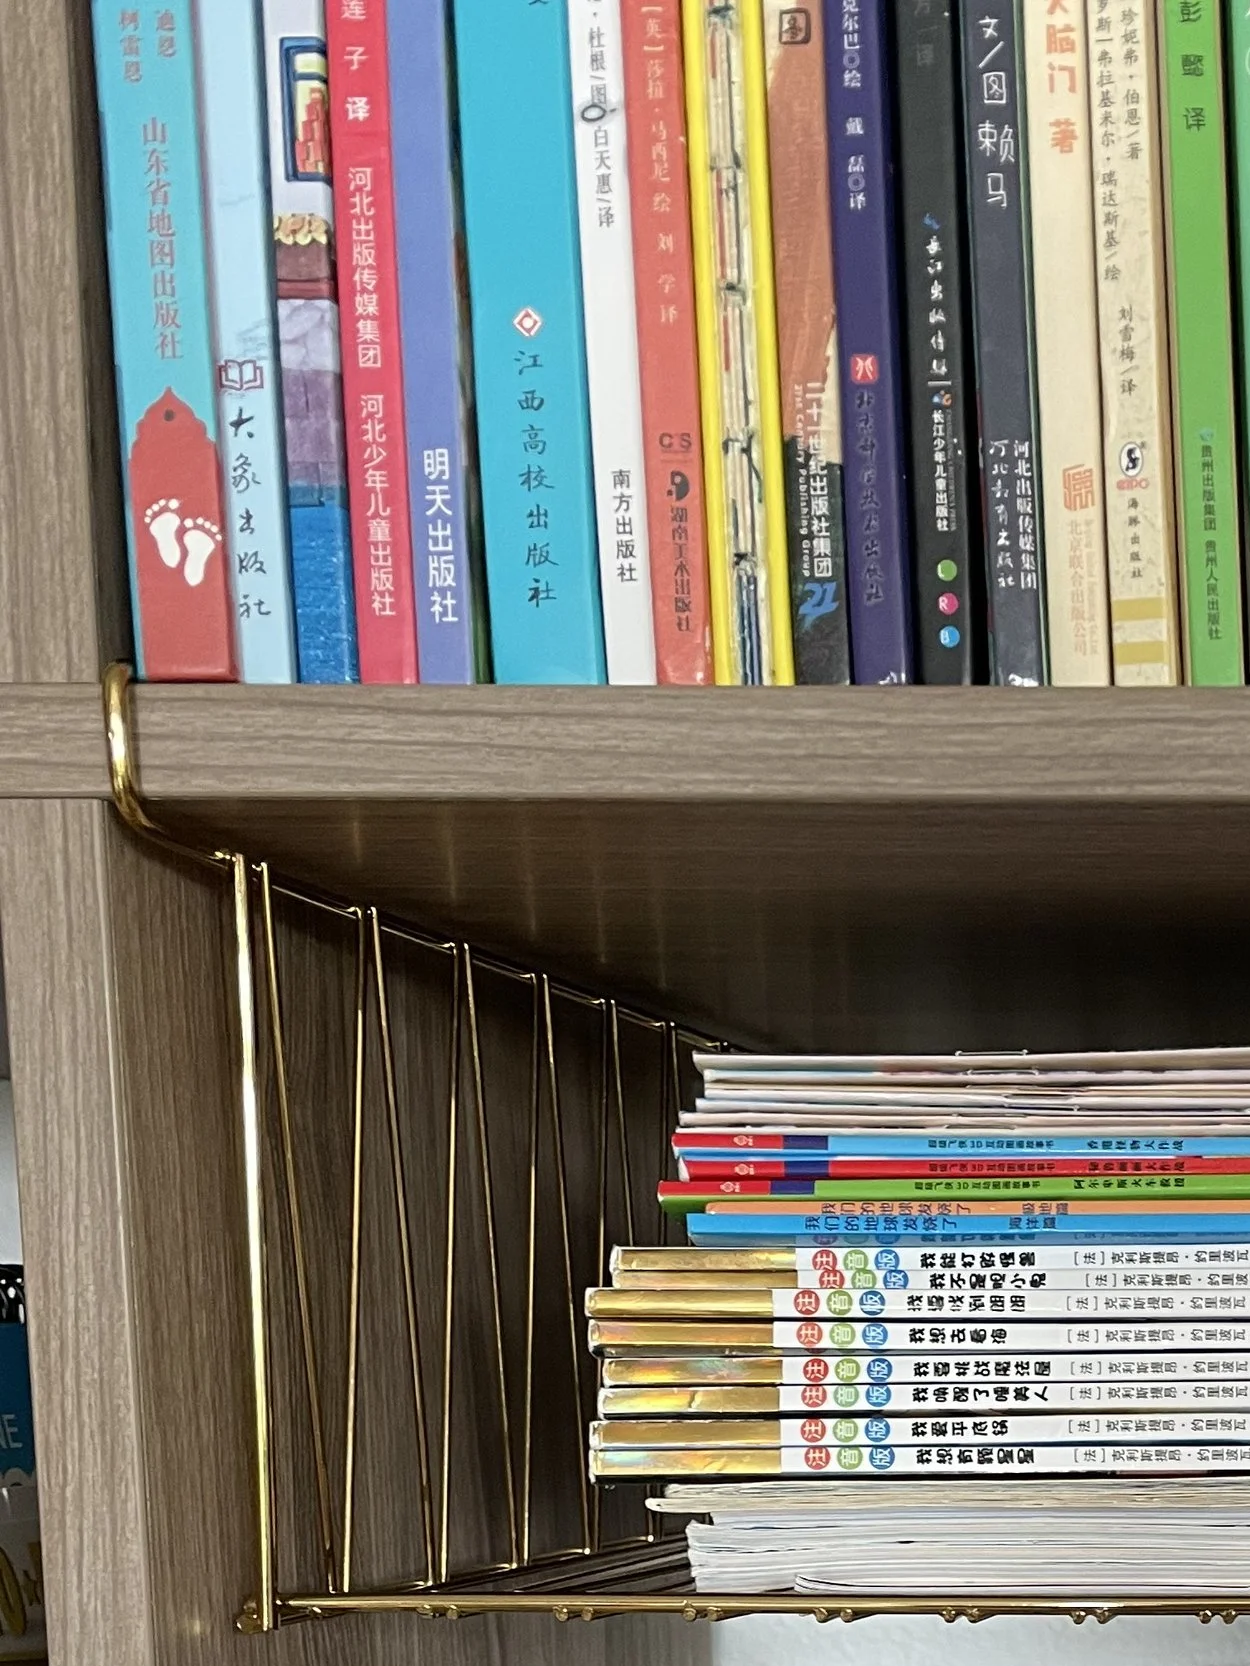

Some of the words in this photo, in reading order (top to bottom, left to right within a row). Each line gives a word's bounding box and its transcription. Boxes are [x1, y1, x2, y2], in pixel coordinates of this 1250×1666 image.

[976, 119, 1016, 210] 赖马
[1050, 117, 1079, 154] 著
[141, 117, 184, 361] 山东省地图出版社
[347, 167, 382, 368] 河北出版传媒集团
[229, 411, 271, 619] 大象出版社
[360, 394, 396, 618] 河北少年儿童出版社
[514, 349, 559, 605] 江西高校出版社
[611, 468, 638, 583] 南方出版社
[805, 382, 832, 578] 二十一世纪出版社集团
[932, 410, 950, 532] 长江少年儿童出版社
[1013, 439, 1037, 590] 河北出版传媒集团
[1201, 445, 1218, 532] 贵州出版集团
[422, 448, 459, 623] 明天出版社
[670, 506, 693, 633] 湖南美术出版社
[804, 1215, 958, 1232] 我们的地球发烧了
[908, 1328, 1008, 1345] 我想去看海
[911, 1419, 1009, 1438] 我爱平底锅
